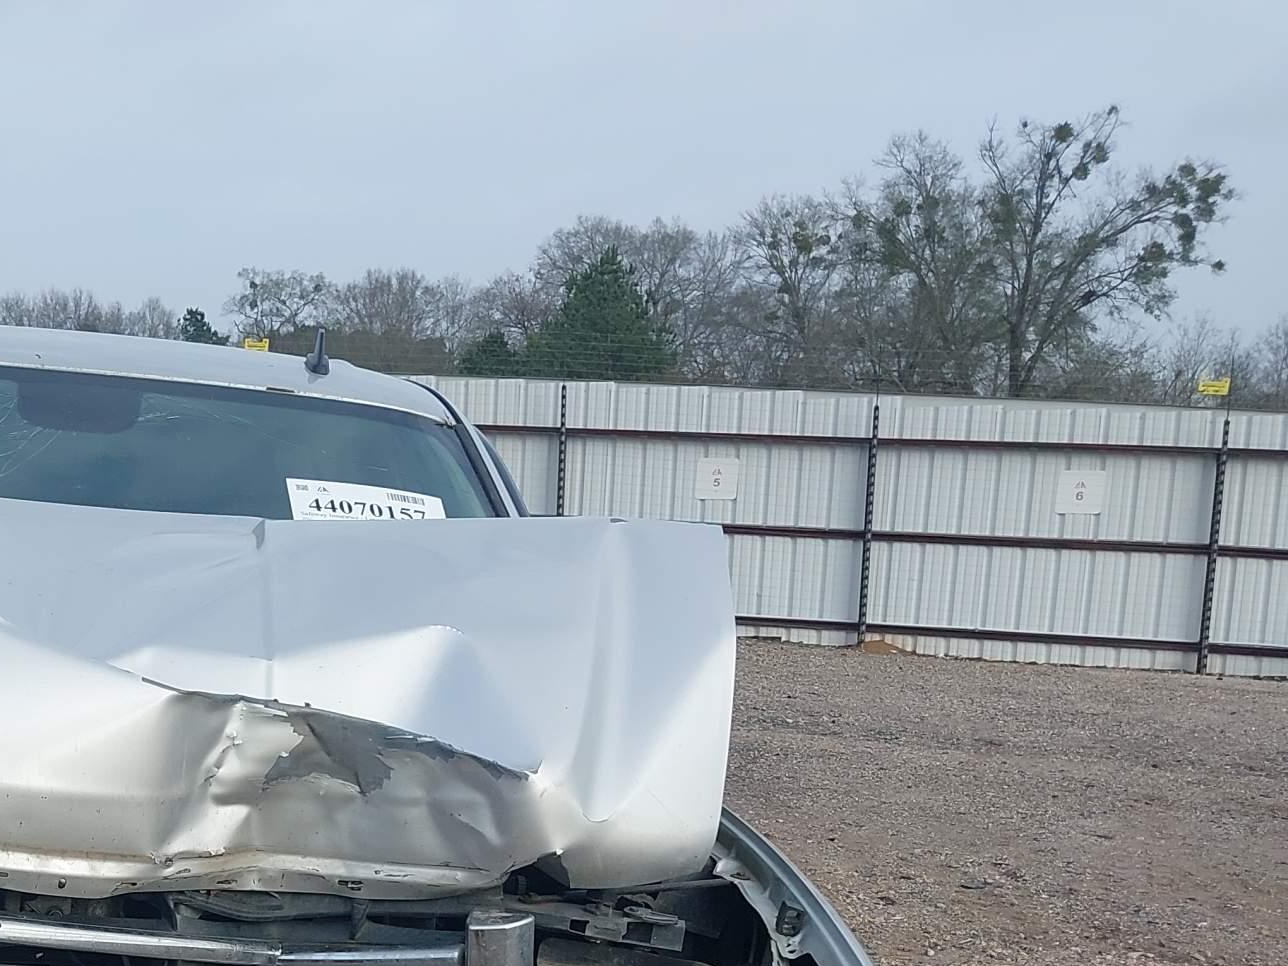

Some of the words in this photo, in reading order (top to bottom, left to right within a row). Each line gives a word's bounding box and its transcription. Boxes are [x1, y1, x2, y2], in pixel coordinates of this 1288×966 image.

[712, 477, 721, 487] 5
[1075, 491, 1084, 501] 6
[308, 498, 426, 520] 44070157
